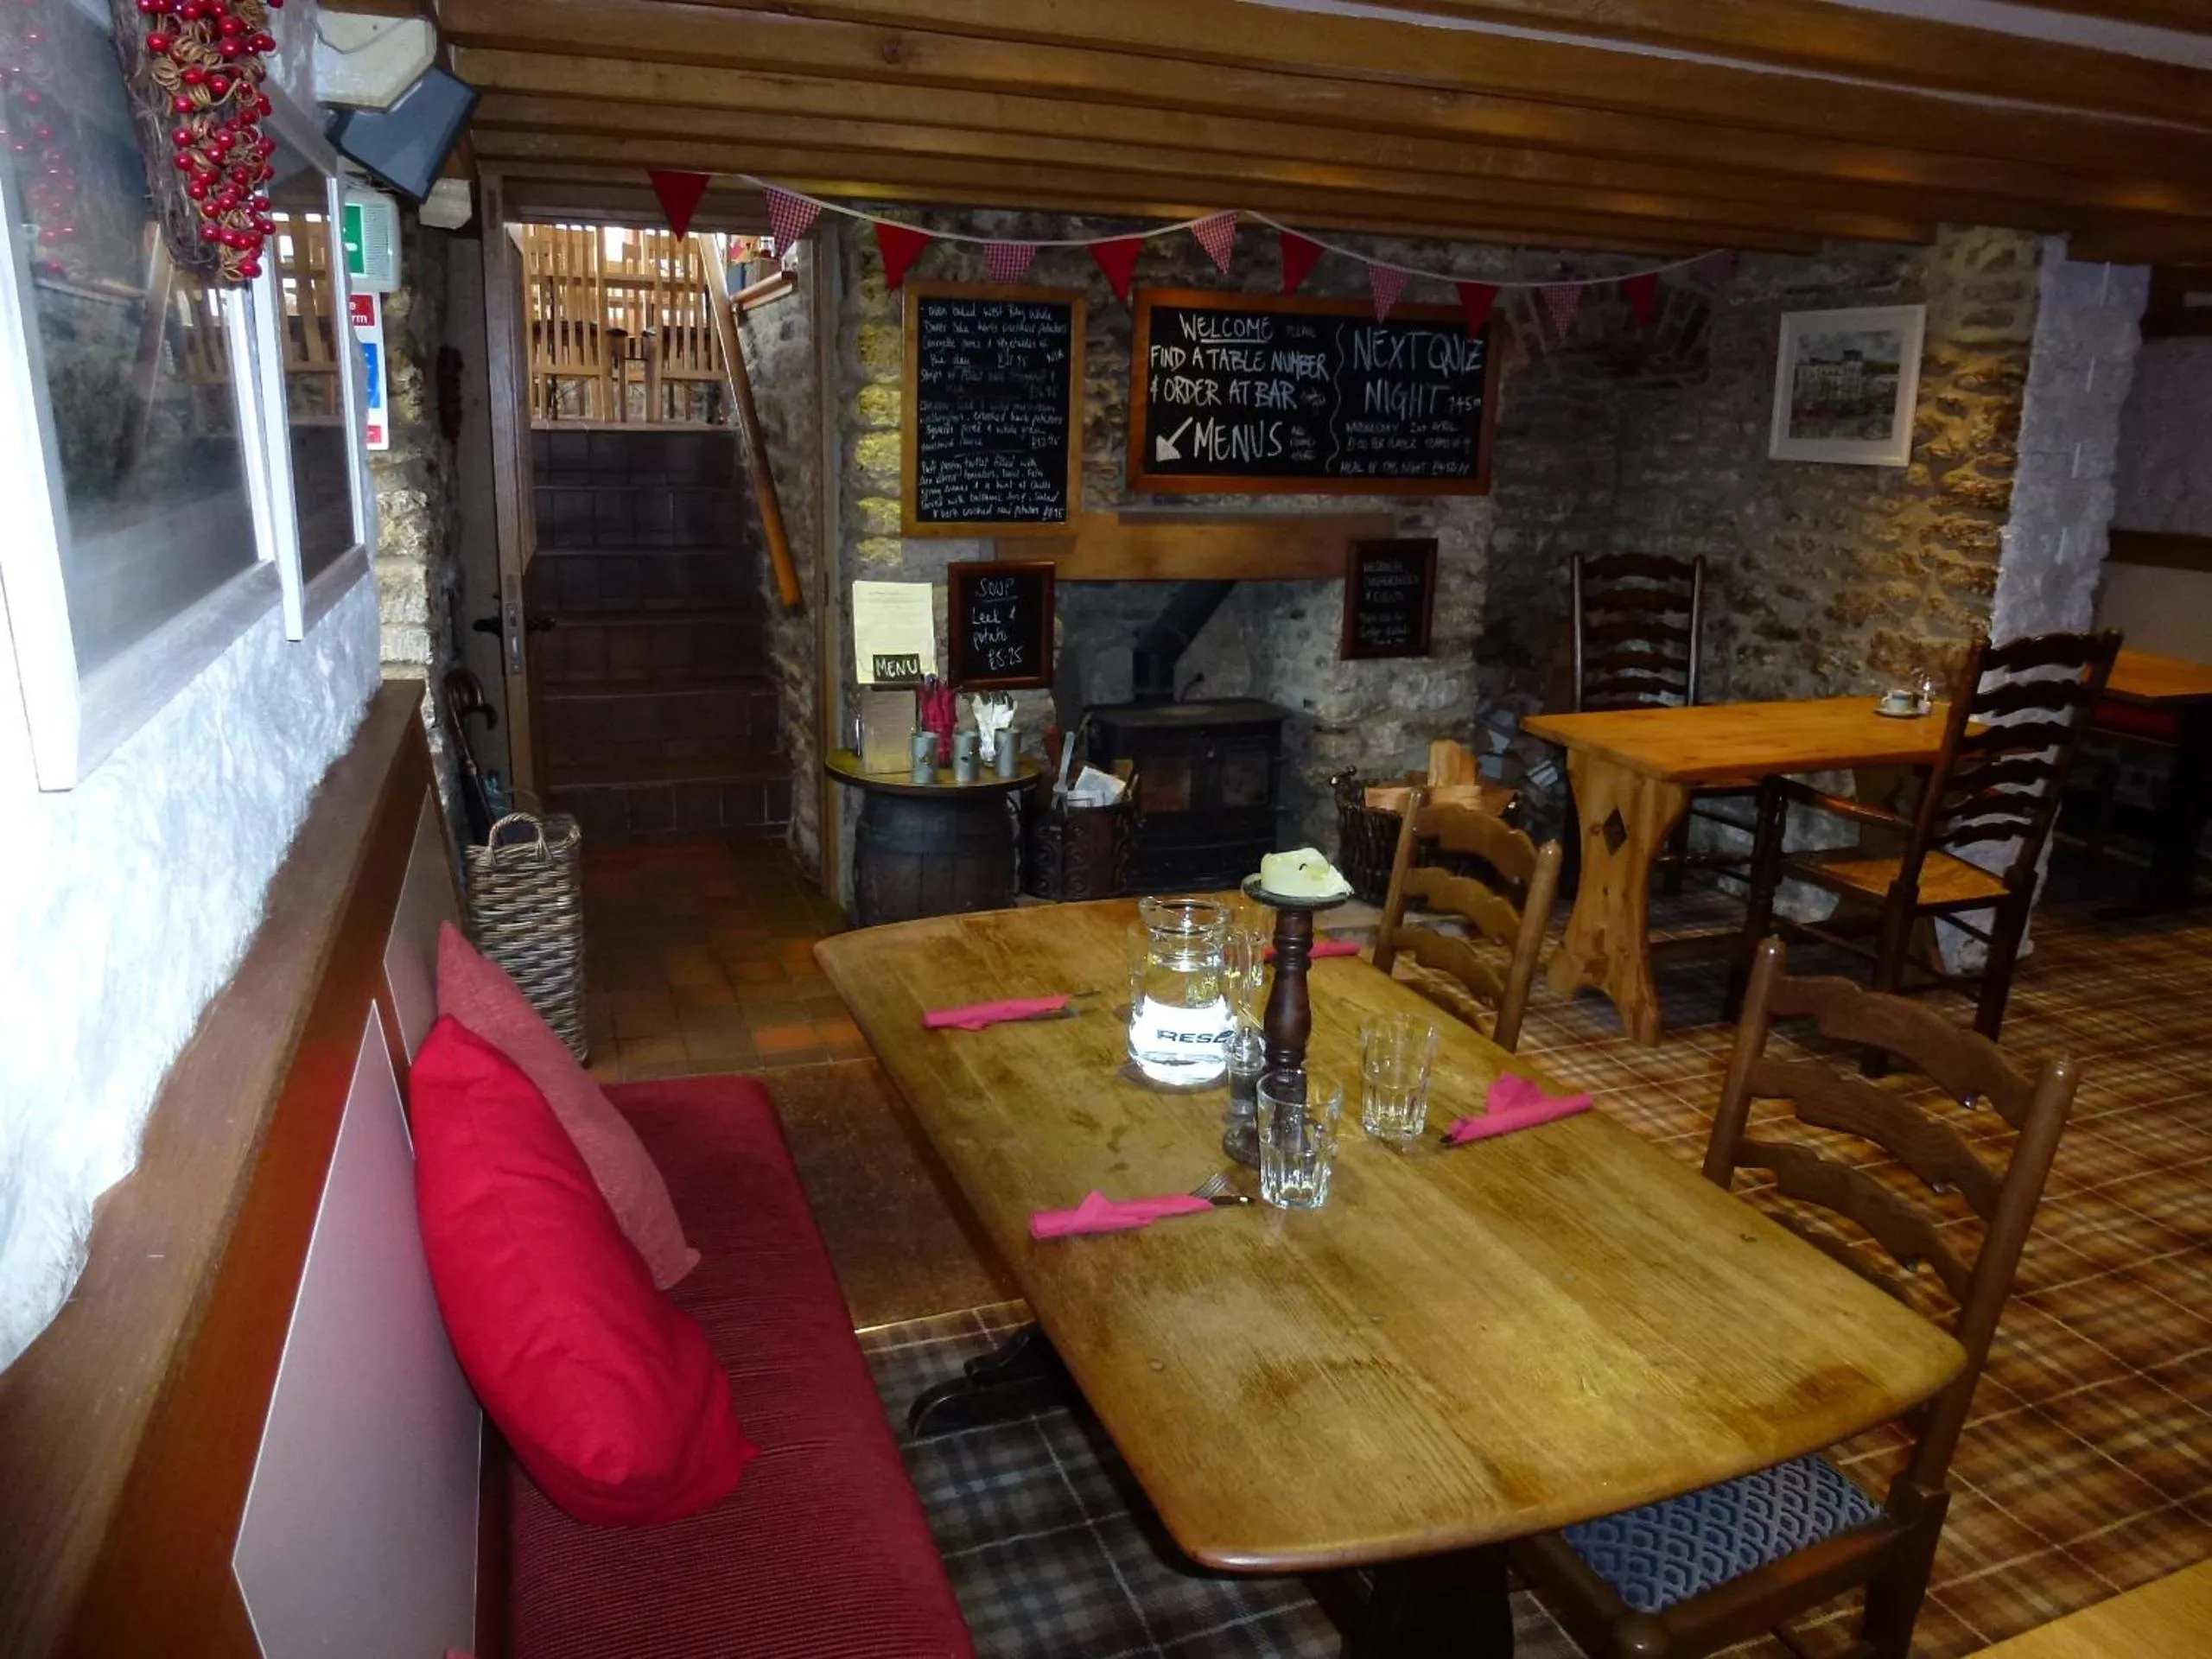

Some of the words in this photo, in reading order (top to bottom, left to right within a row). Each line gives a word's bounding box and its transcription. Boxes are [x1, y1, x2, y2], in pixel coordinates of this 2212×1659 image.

[1179, 312, 1274, 341] WELCOME
[1150, 345, 1186, 372] FIND
[1192, 346, 1205, 370] A
[1206, 347, 1266, 372] TABLE
[1271, 349, 1330, 382] NUMBER
[1354, 327, 1431, 372] NEXT
[1427, 332, 1484, 378] QUIZ
[1150, 374, 1159, 404] &
[1163, 375, 1222, 406] ORDER
[1229, 378, 1251, 405] AT
[1255, 378, 1299, 410] BAR
[1364, 378, 1452, 421] NIGHT
[1193, 416, 1283, 463] MENUS
[976, 577, 1014, 596] SOUP
[971, 606, 1002, 625] Leek
[875, 657, 918, 677] MENU
